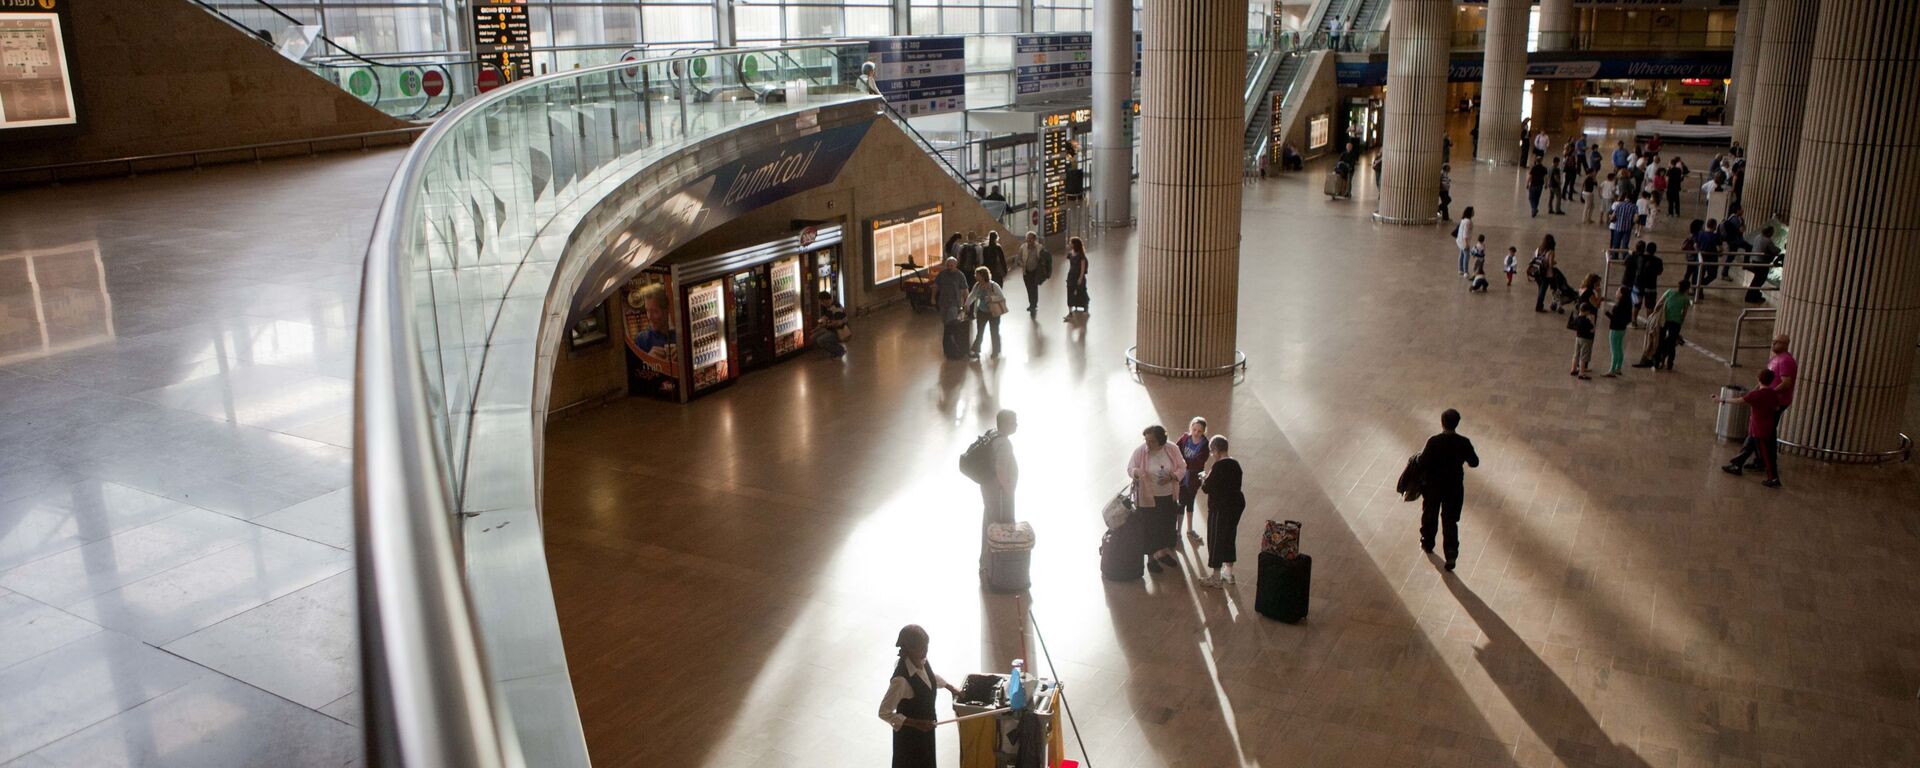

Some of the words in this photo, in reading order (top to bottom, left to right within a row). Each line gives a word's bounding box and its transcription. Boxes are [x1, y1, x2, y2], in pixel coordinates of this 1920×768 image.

[1627, 61, 1695, 75] Wherever
[1699, 63, 1728, 76] you
[720, 140, 821, 208] leumi.co.il
